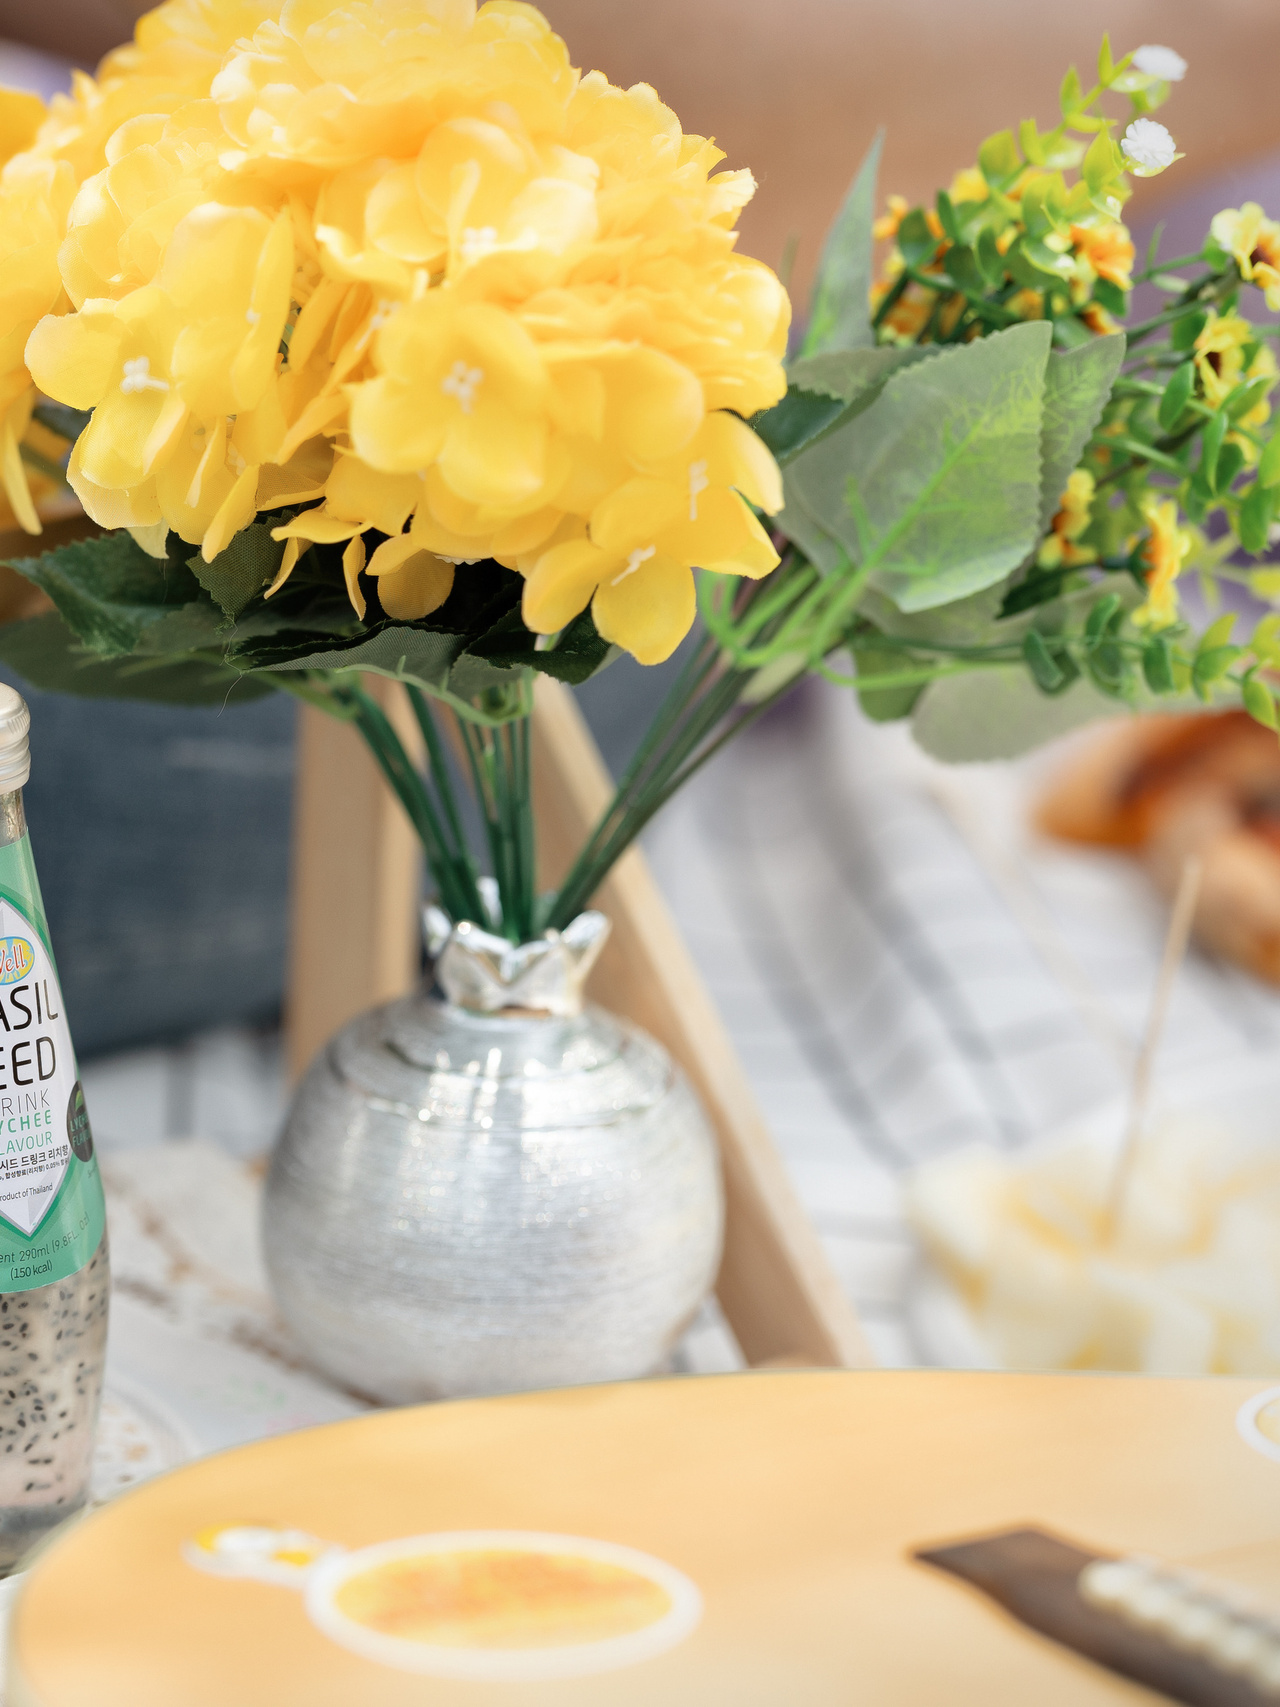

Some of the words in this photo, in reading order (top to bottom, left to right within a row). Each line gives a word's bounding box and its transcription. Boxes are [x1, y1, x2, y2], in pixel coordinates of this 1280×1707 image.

[20, 1151, 47, 1167] 드링크
[48, 1143, 69, 1160] 리치향
[21, 1188, 29, 1197] of
[29, 1182, 54, 1196] Thailand
[19, 1243, 51, 1263] 290ml
[10, 1267, 32, 1281] (150
[32, 1259, 54, 1277] kcal)
